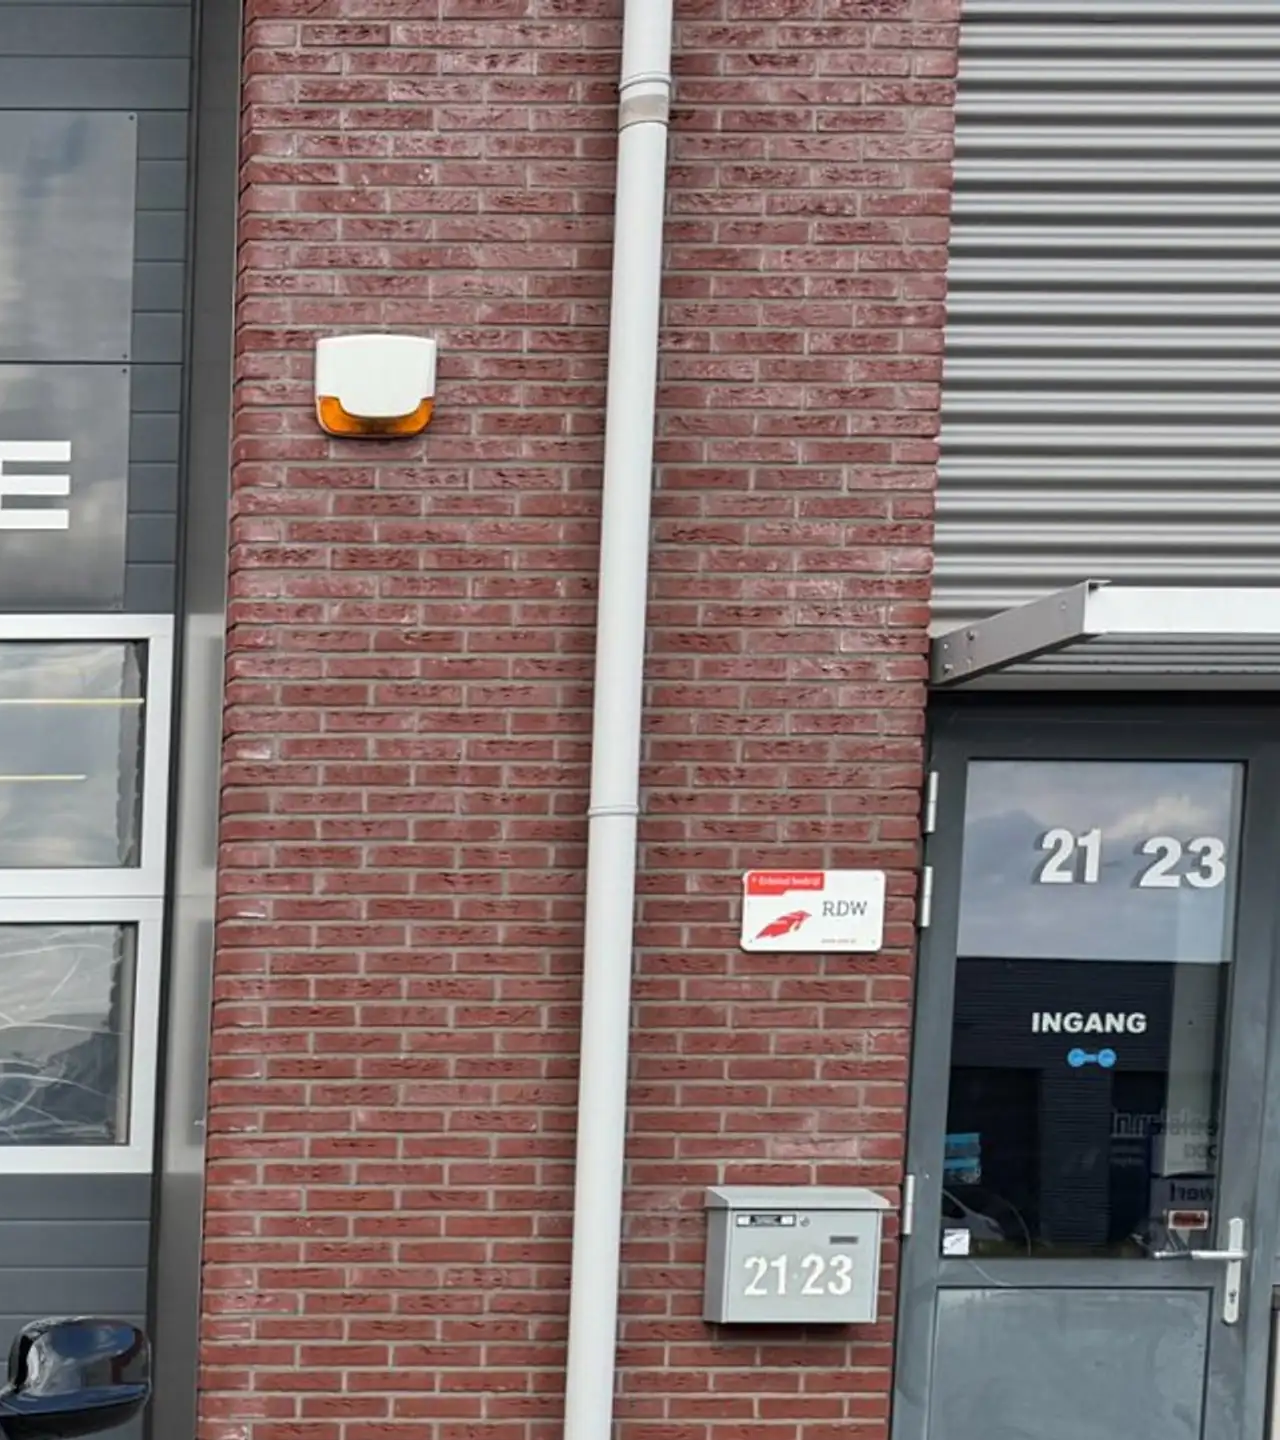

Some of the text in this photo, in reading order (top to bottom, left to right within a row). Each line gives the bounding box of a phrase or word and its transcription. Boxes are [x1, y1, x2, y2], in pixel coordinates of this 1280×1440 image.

[1039, 827, 1226, 889] 21 23
[822, 900, 868, 917] RDW
[1031, 1011, 1148, 1034] INGANG
[800, 1252, 853, 1296] 23
